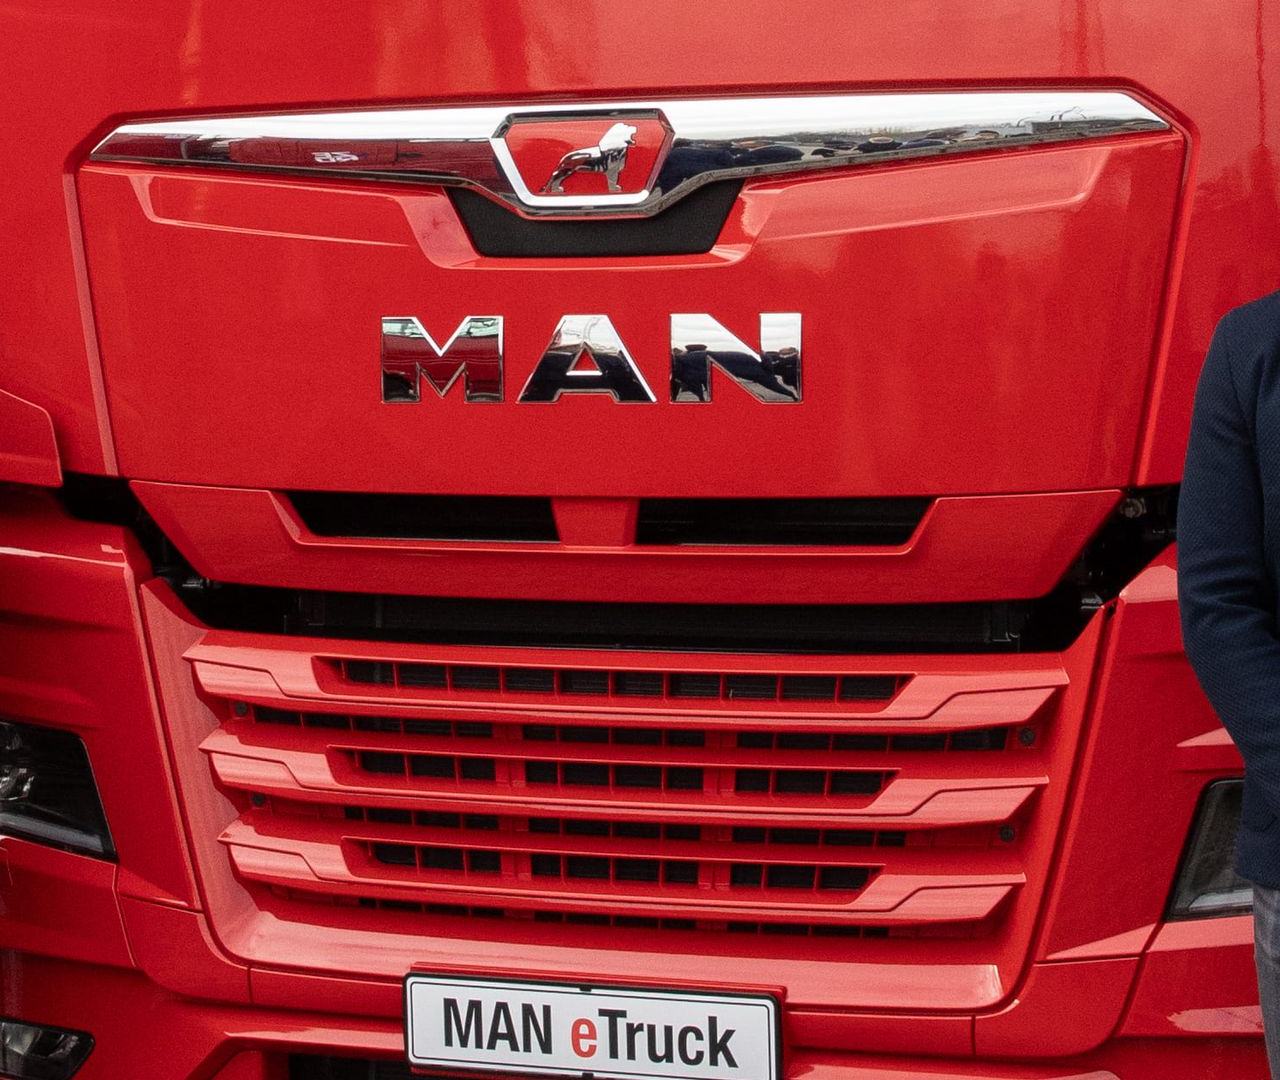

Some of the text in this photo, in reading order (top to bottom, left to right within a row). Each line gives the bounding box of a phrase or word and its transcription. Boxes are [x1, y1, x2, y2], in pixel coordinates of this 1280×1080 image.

[381, 313, 803, 404] MAN
[443, 997, 739, 1069] MAN eTruck
